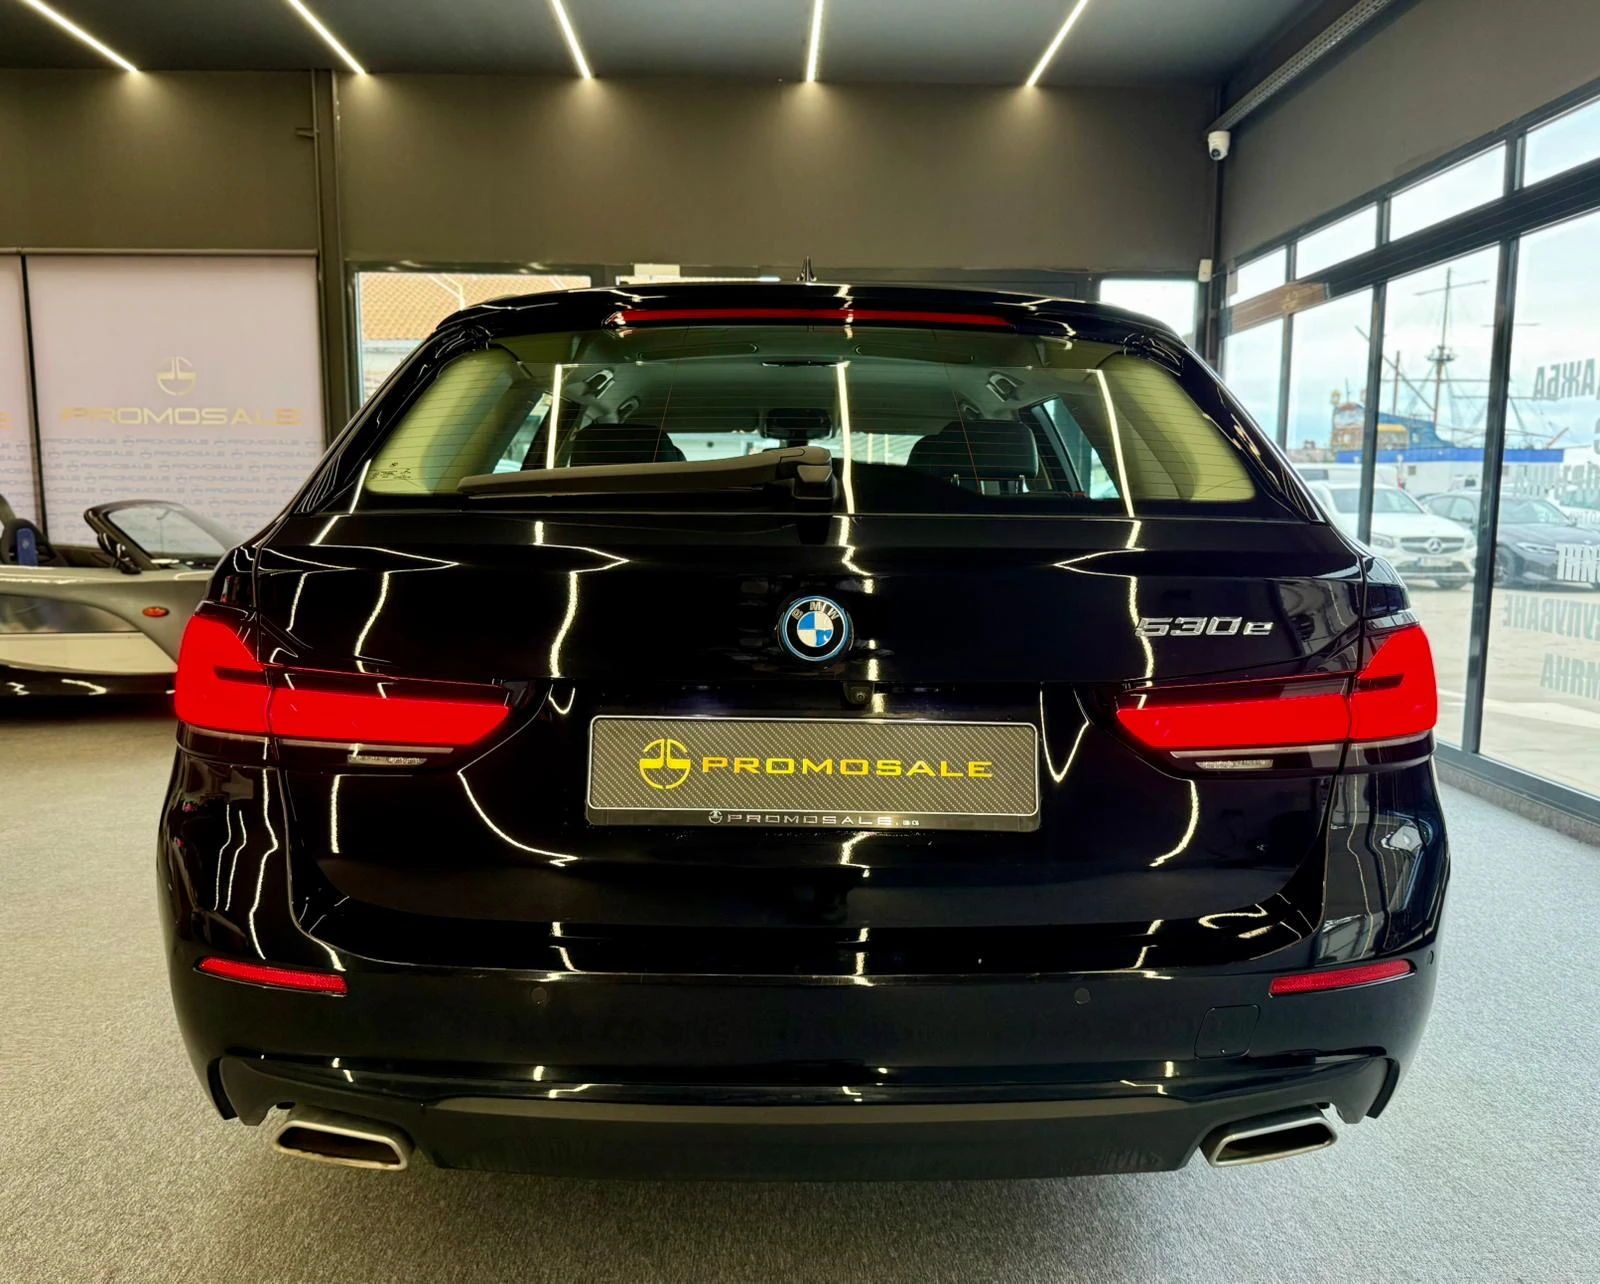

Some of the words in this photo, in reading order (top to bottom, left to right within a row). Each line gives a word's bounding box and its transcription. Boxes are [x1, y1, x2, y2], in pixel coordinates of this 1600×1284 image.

[61, 406, 303, 426] PROMOSALE
[791, 601, 840, 621] BMW
[1134, 616, 1274, 637] 530e
[702, 756, 994, 778] PROMOSALE
